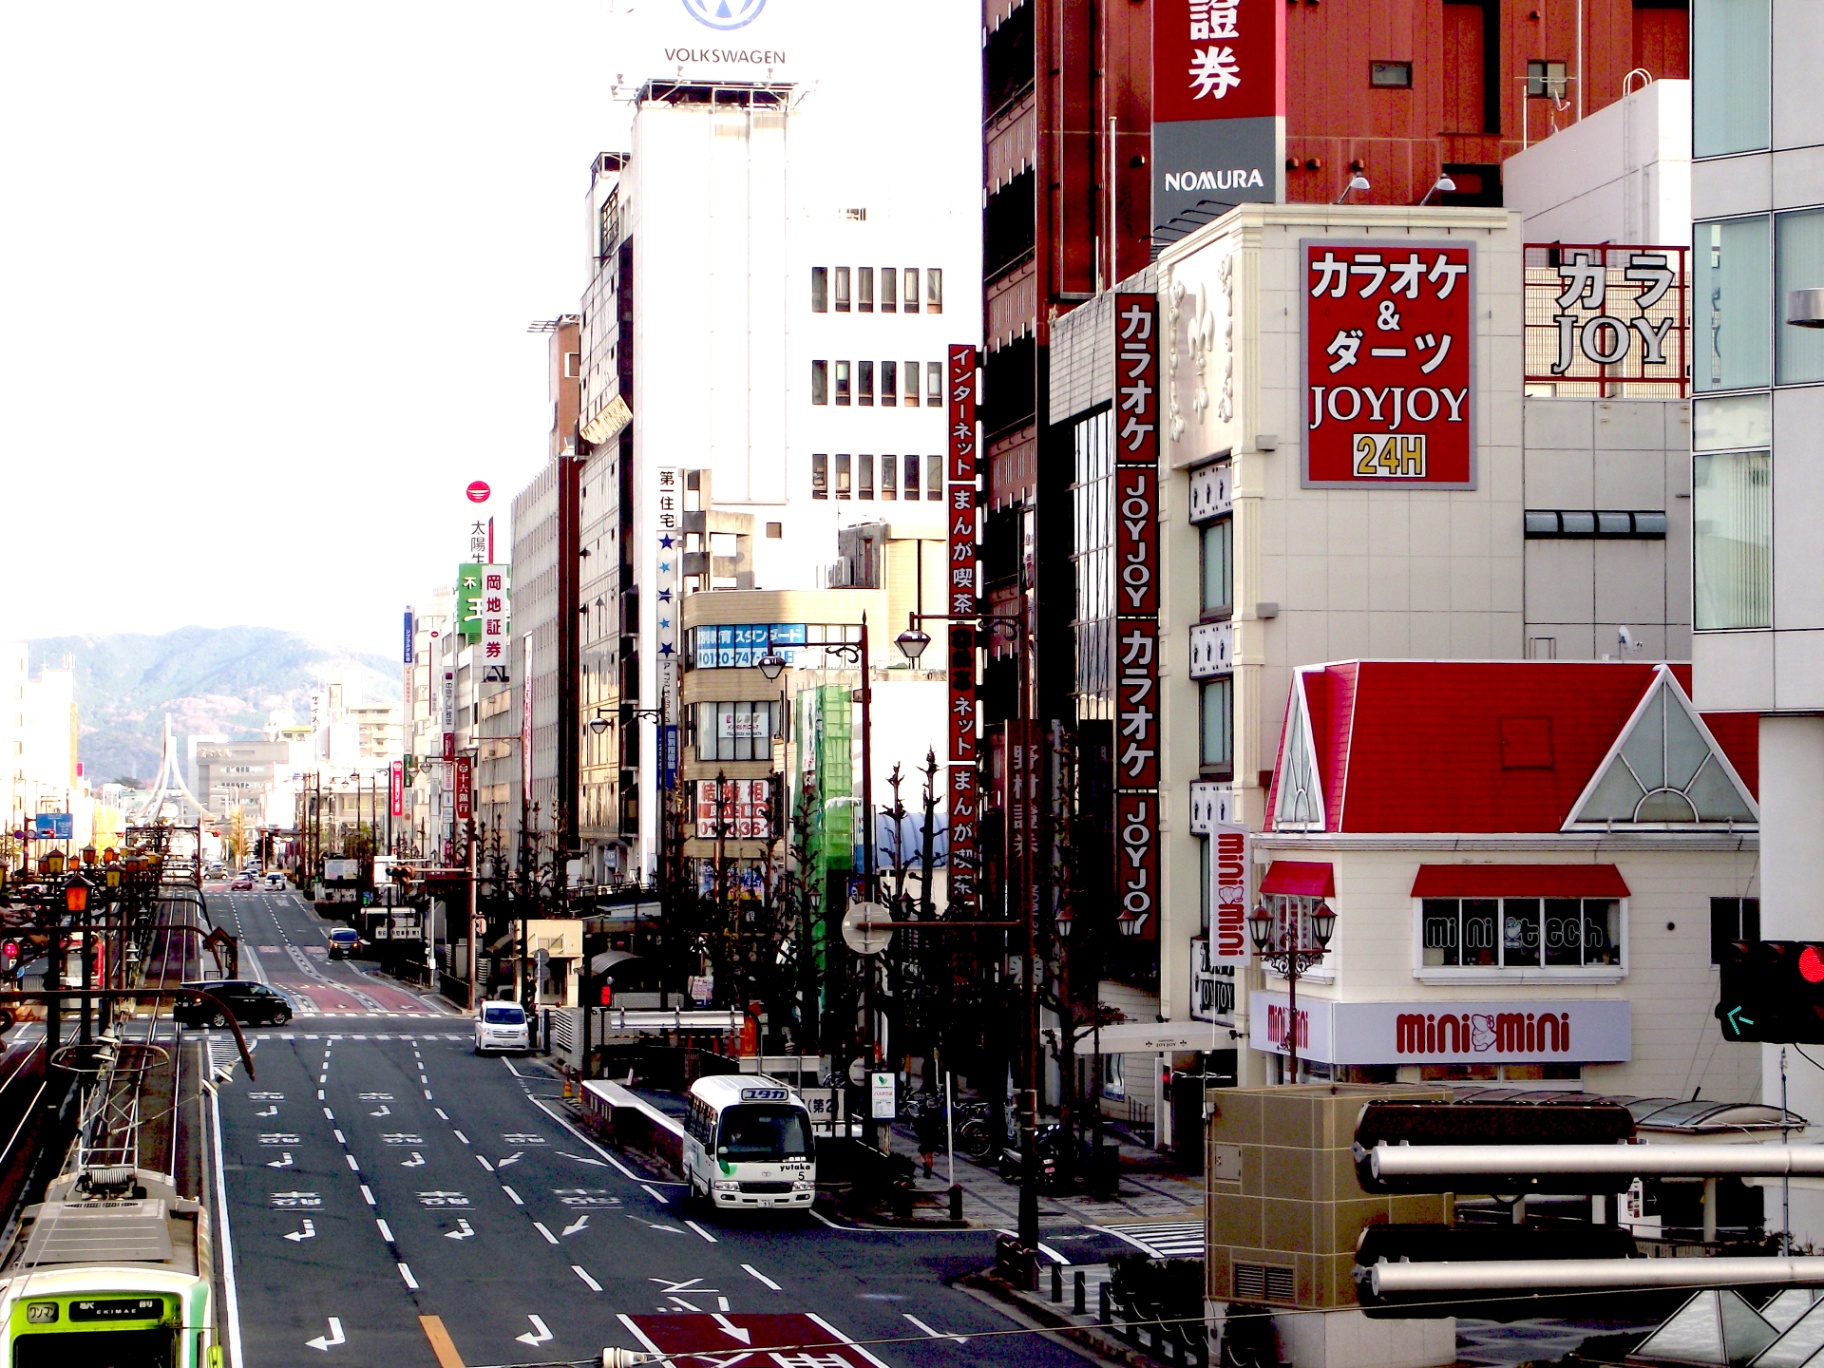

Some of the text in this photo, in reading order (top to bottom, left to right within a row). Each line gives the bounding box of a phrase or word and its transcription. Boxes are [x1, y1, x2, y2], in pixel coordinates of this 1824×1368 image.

[664, 48, 786, 64] VOLKSWAGEN
[1165, 169, 1264, 192] NOMURA
[1310, 252, 1468, 300] カラオケ
[1376, 300, 1401, 330] &
[1326, 329, 1453, 375] ダーツ
[1551, 315, 1675, 374] JOY
[1120, 304, 1154, 451] カラオケ
[952, 349, 973, 476] インターネット
[1309, 386, 1468, 430] JOYJOY
[1356, 435, 1424, 476] 24H
[659, 471, 675, 528] 第一住宅
[952, 490, 973, 614] まんが喫茶
[1121, 475, 1151, 607] JOYJOY
[486, 575, 502, 658] 岡地証券
[1121, 630, 1155, 777] カラオケ
[953, 771, 974, 894] まんが喫茶
[1122, 801, 1151, 935] JOYJOY
[1217, 833, 1245, 886] mini
[1217, 904, 1245, 956] mini
[1425, 917, 1604, 948] mini tech
[1292, 1010, 1309, 1050] ini
[1396, 1012, 1570, 1054] mini mini
[744, 1090, 787, 1099] ユタカ
[780, 1163, 811, 1172] yutaka
[797, 1171, 805, 1181] 5
